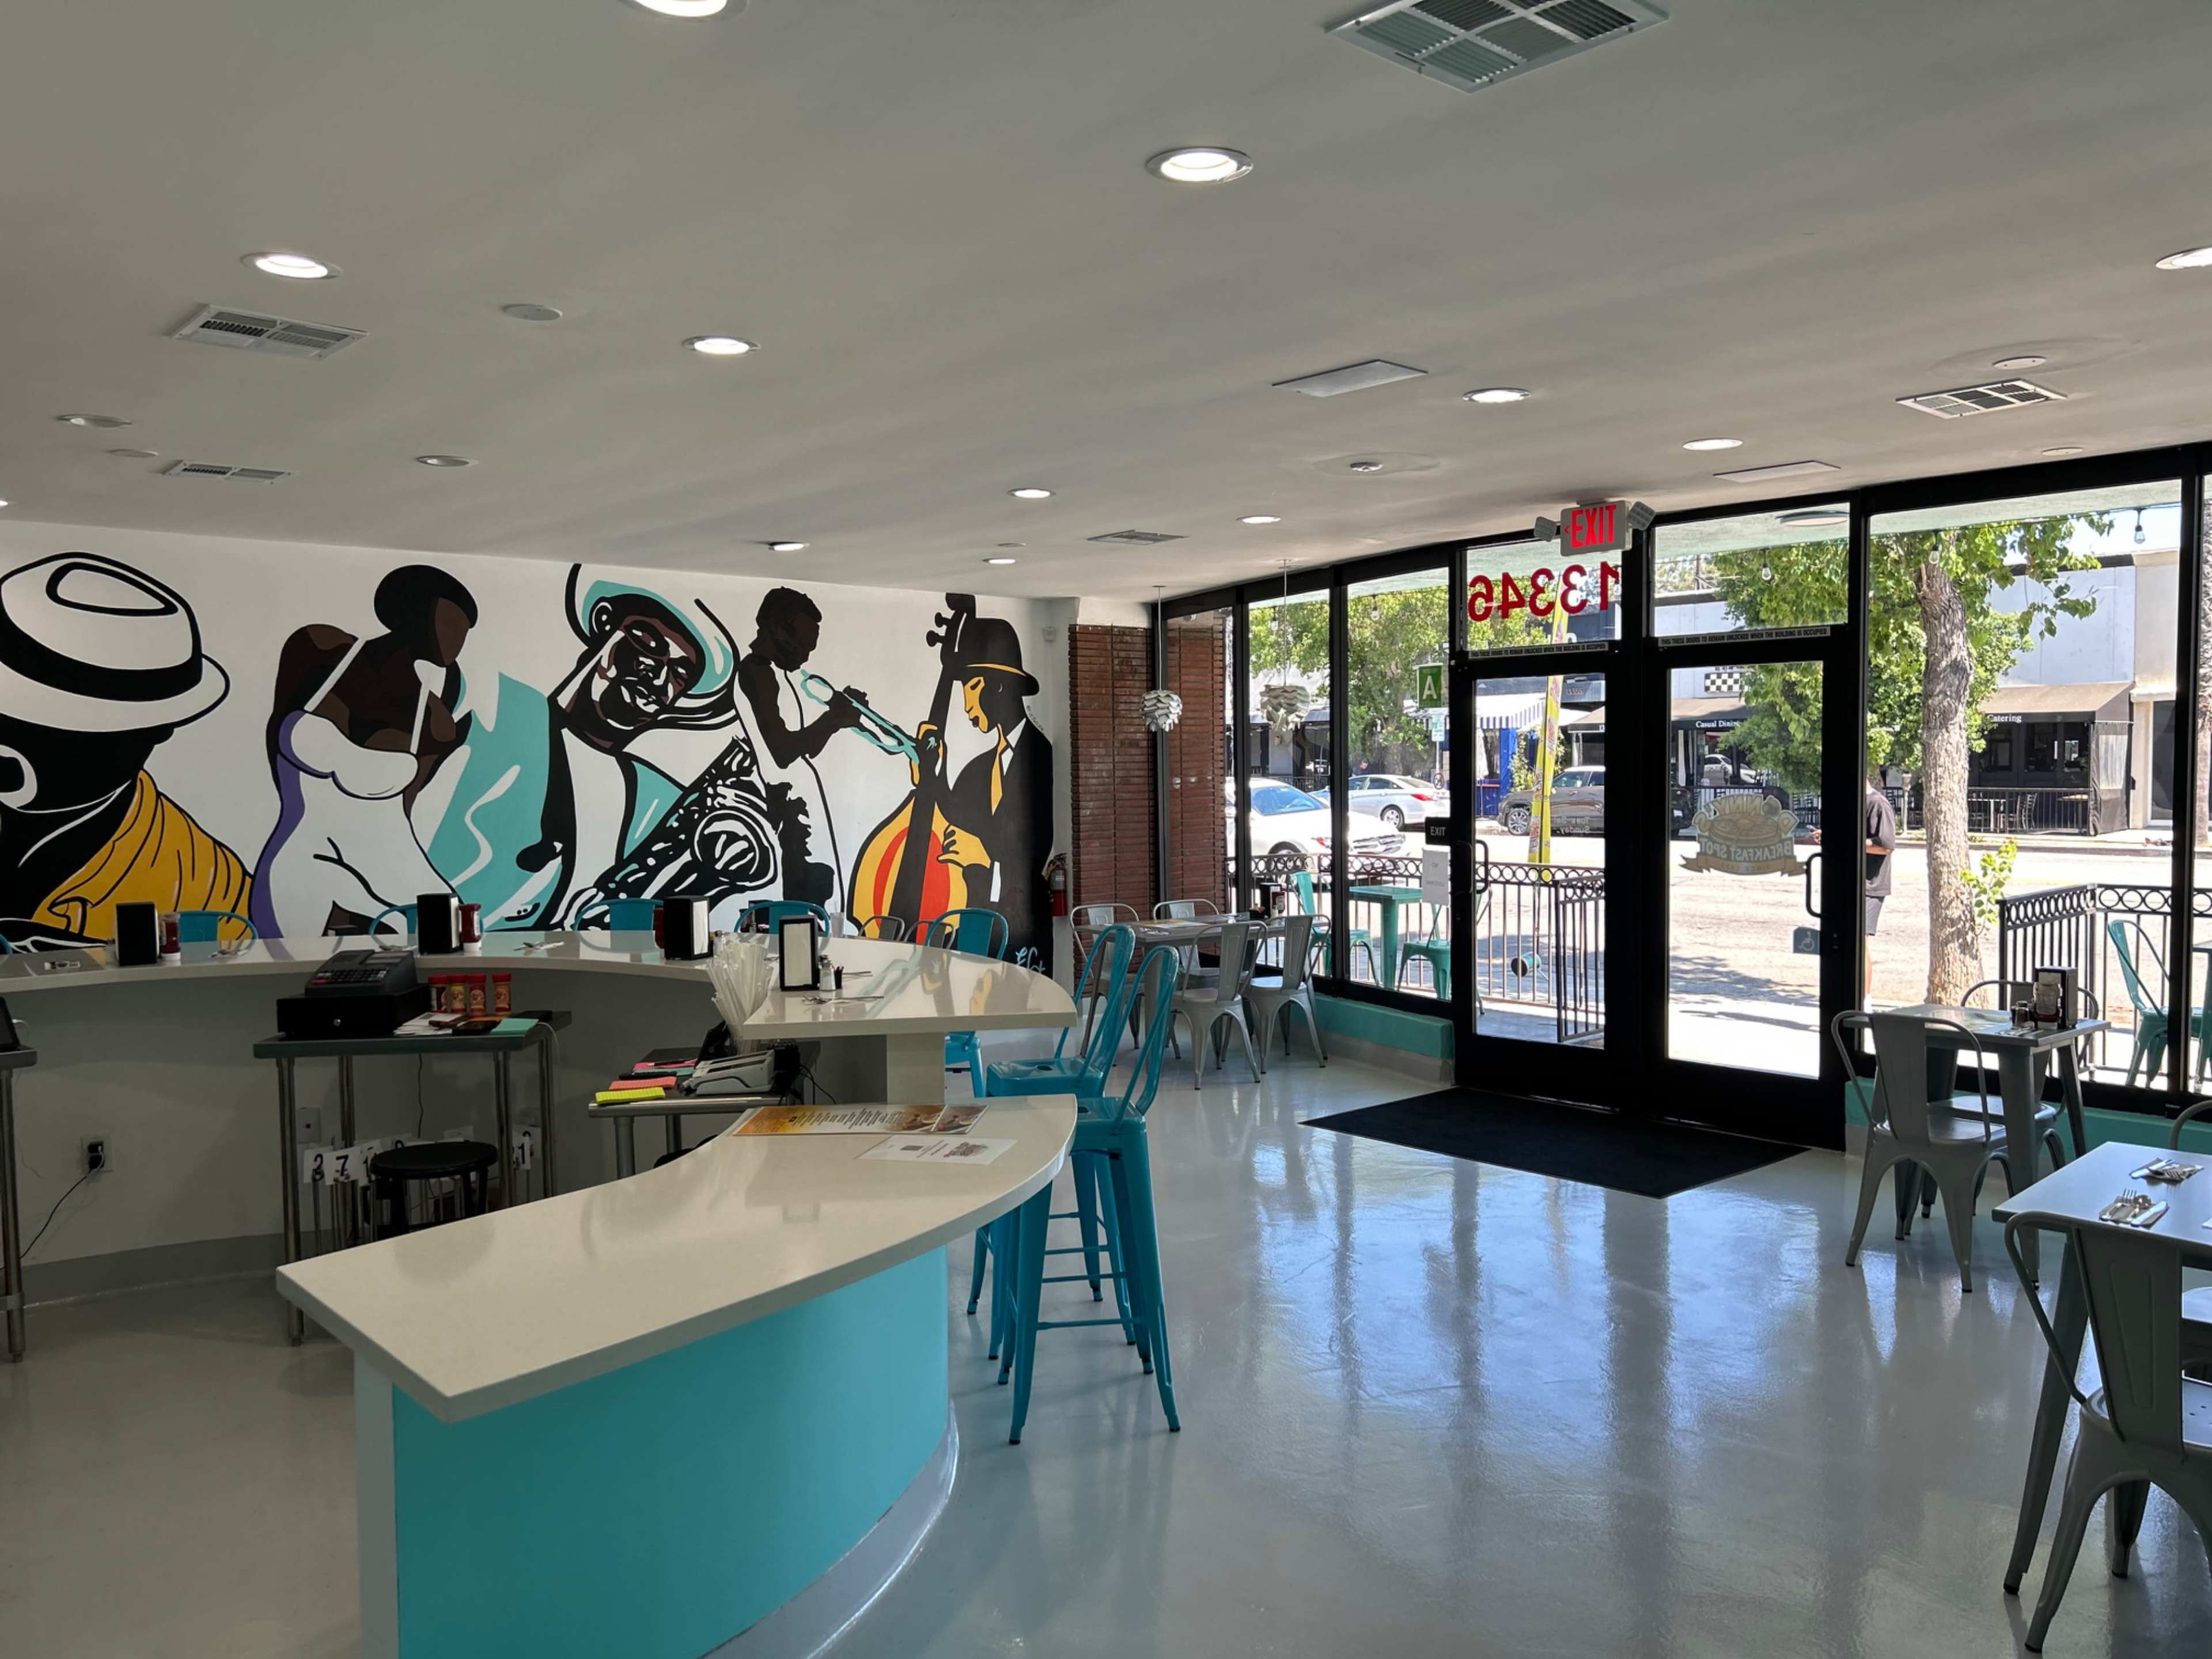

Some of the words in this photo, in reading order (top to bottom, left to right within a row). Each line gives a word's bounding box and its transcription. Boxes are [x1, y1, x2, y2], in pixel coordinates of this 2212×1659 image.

[1571, 504, 1616, 548] EXIT
[1775, 630, 1796, 638] BUILDING
[1803, 628, 1827, 636] OCCUPIED
[1423, 675, 1437, 699] A
[1987, 714, 2022, 724] Catering
[1430, 827, 1446, 836] EXIT
[336, 1154, 349, 1176] 7
